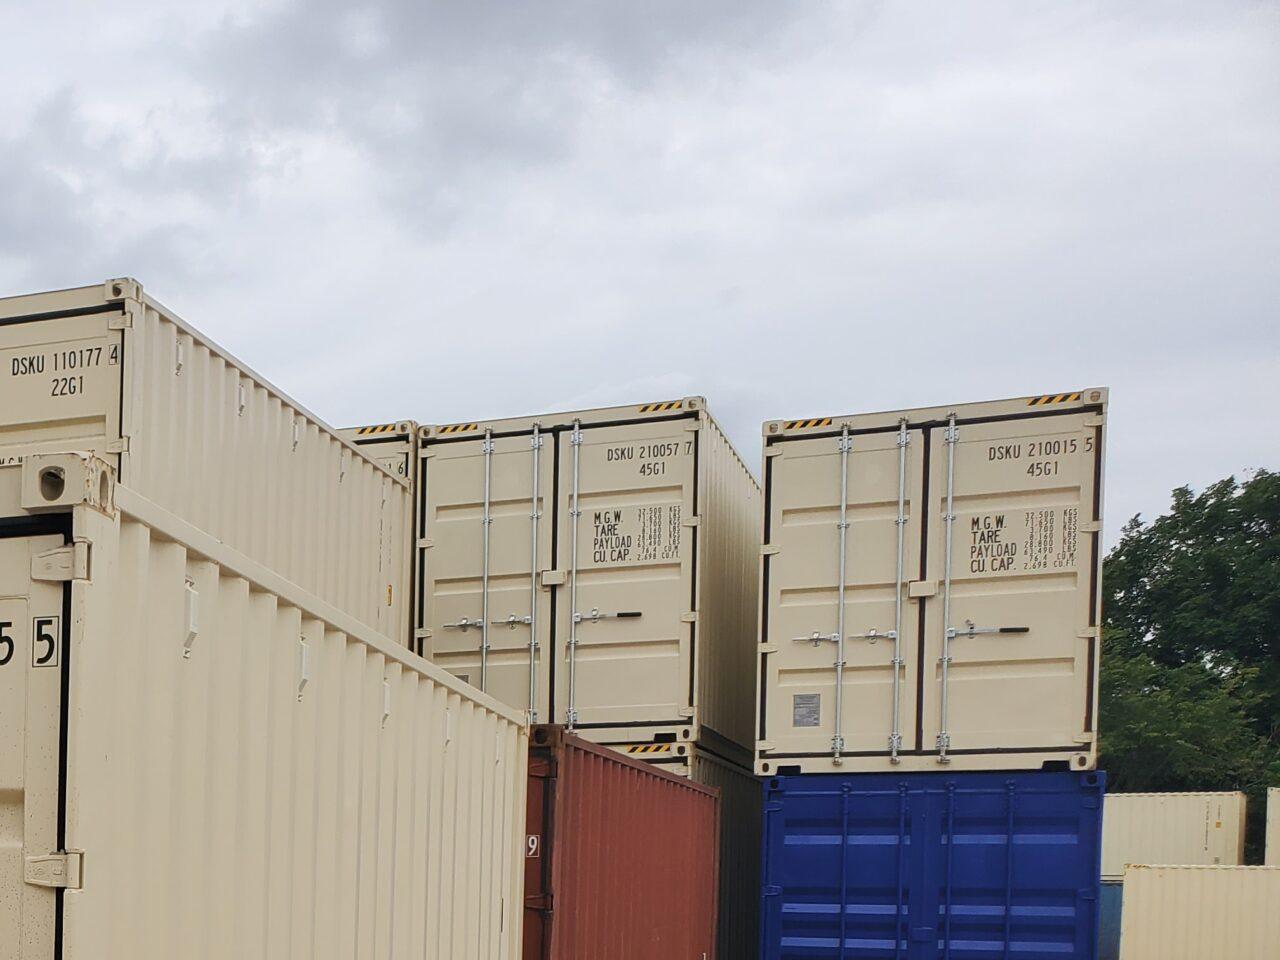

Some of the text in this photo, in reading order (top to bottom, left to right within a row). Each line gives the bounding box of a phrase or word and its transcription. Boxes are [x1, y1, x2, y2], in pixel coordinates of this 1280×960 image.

[12, 355, 45, 376] DSKU
[53, 347, 102, 371] 110177
[51, 376, 83, 397] 22G1
[607, 446, 634, 462] DSKU
[639, 442, 679, 459] 210057
[988, 444, 1021, 461] DSKU
[1028, 439, 1077, 457] 210015
[639, 461, 665, 476] 45G1
[1027, 461, 1058, 477] 45G1
[594, 523, 619, 537] TARE
[971, 529, 1001, 545] TARE
[593, 535, 632, 550] PAYLOAD
[970, 543, 1017, 559] PAYLOAD
[36, 619, 55, 664] 5
[528, 836, 537, 855] 9
